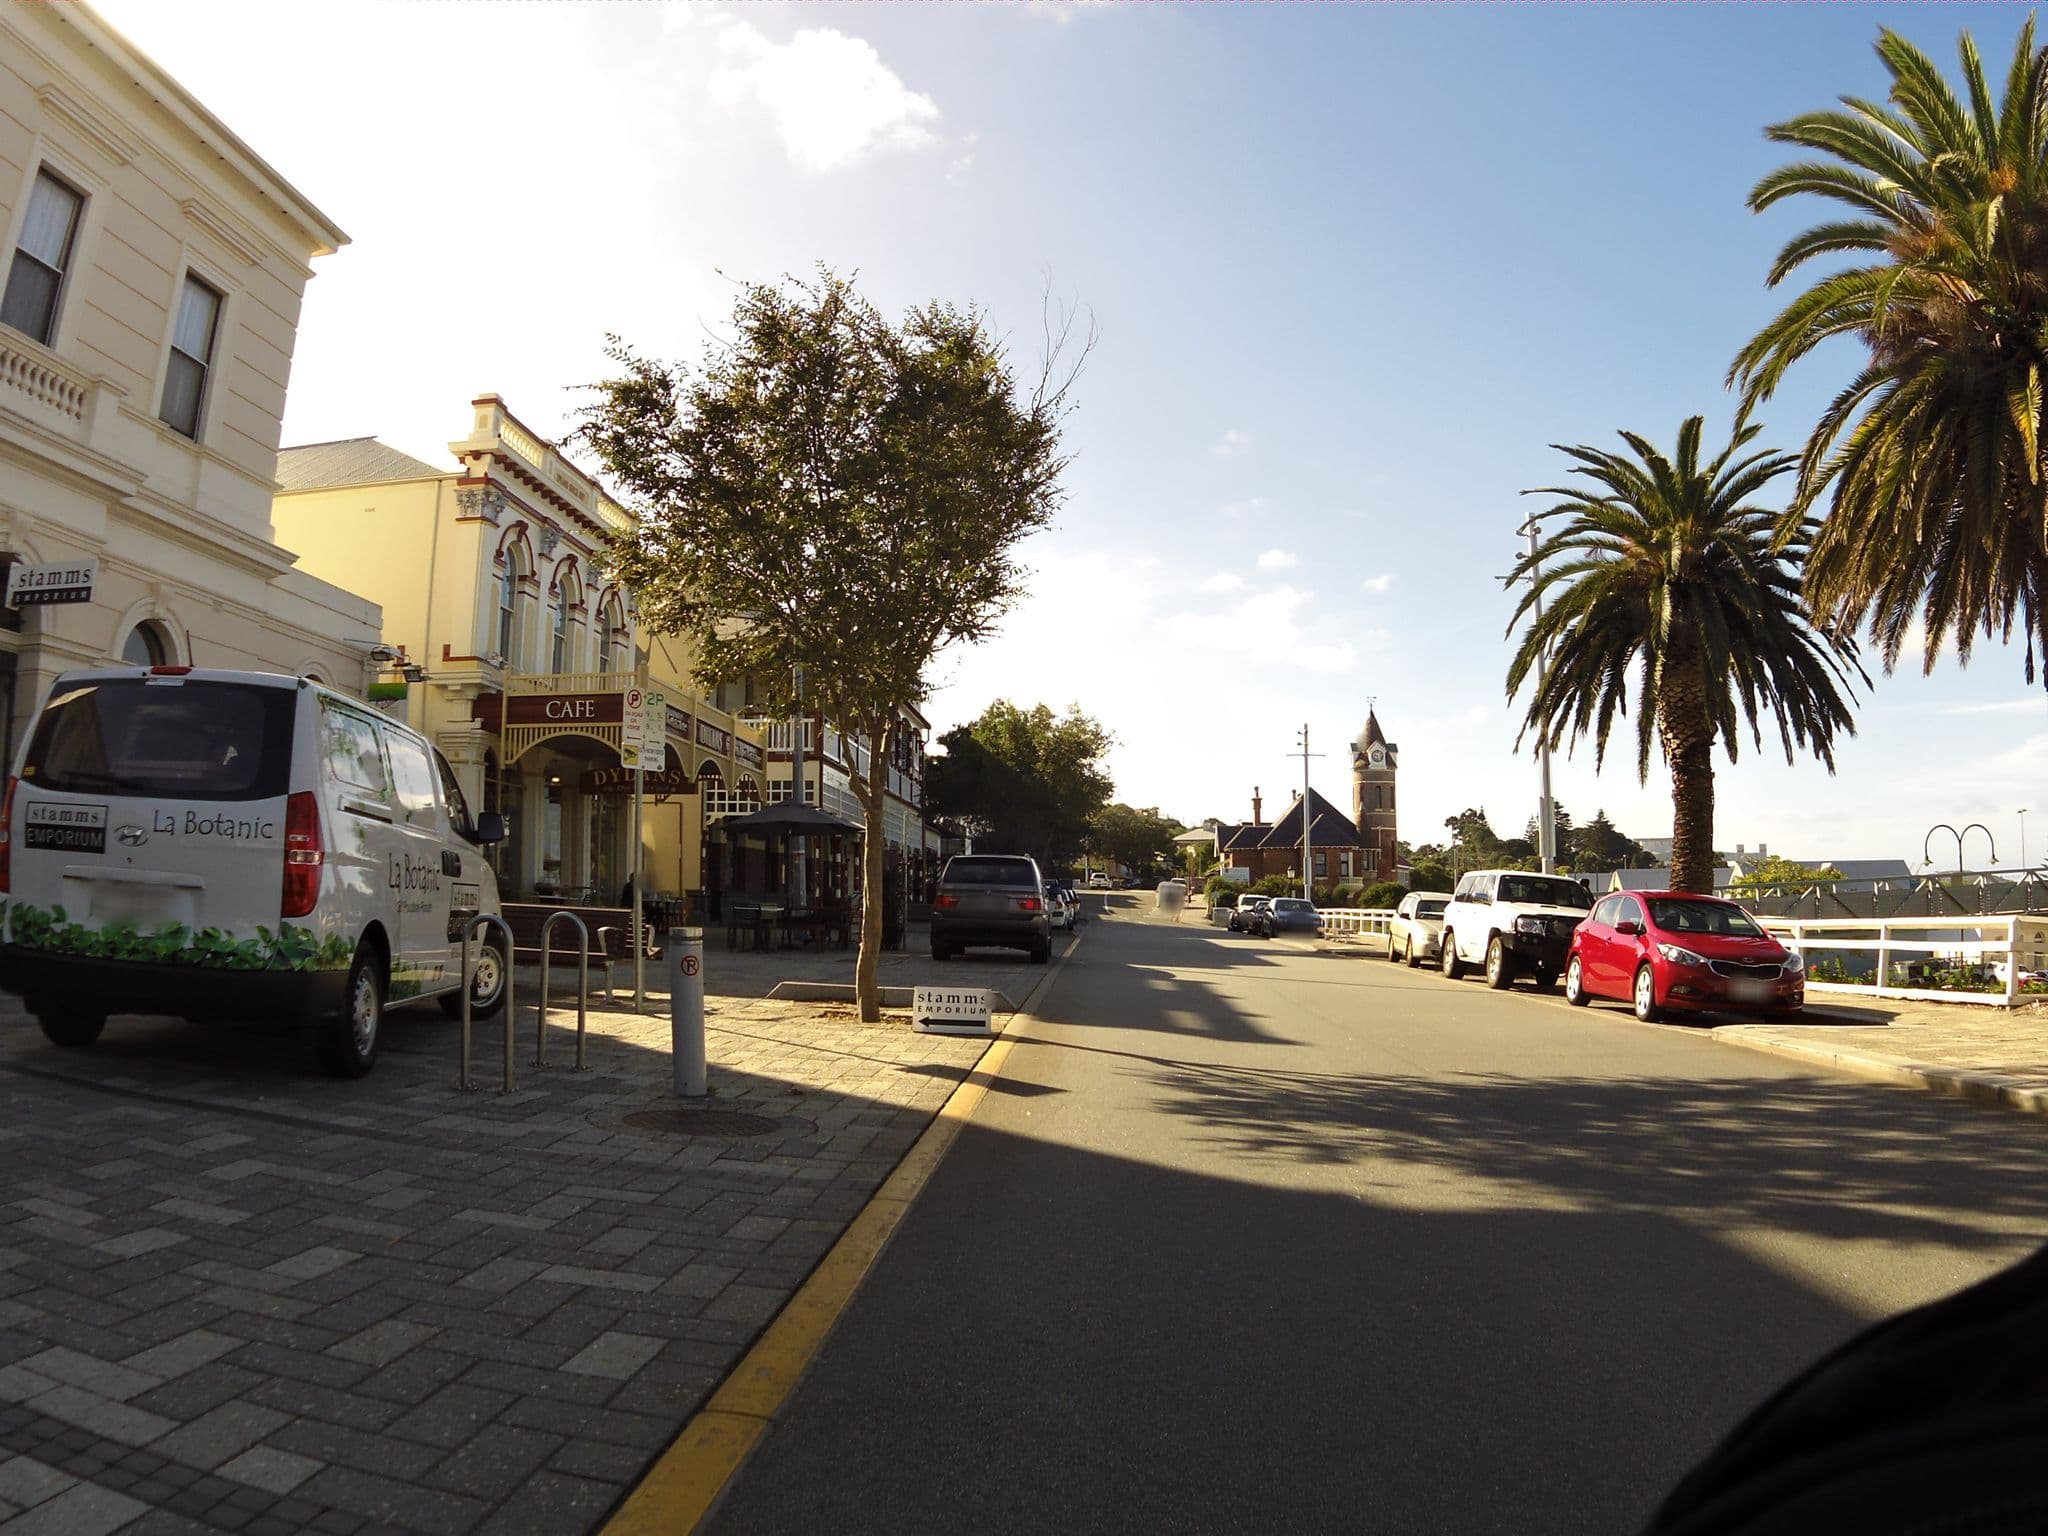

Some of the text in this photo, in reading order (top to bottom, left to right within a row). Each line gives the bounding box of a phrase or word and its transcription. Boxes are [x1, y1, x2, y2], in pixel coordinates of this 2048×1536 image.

[19, 569, 91, 588] stamms
[647, 692, 664, 706] 2P
[545, 700, 595, 719] CAFE
[593, 768, 681, 785] DYLNS
[32, 807, 99, 824] stamms
[153, 809, 273, 840] La Botanic
[27, 828, 104, 849] EMPORIUM
[388, 852, 440, 894] La Botanic
[918, 1005, 987, 1015] EMPORIUM
